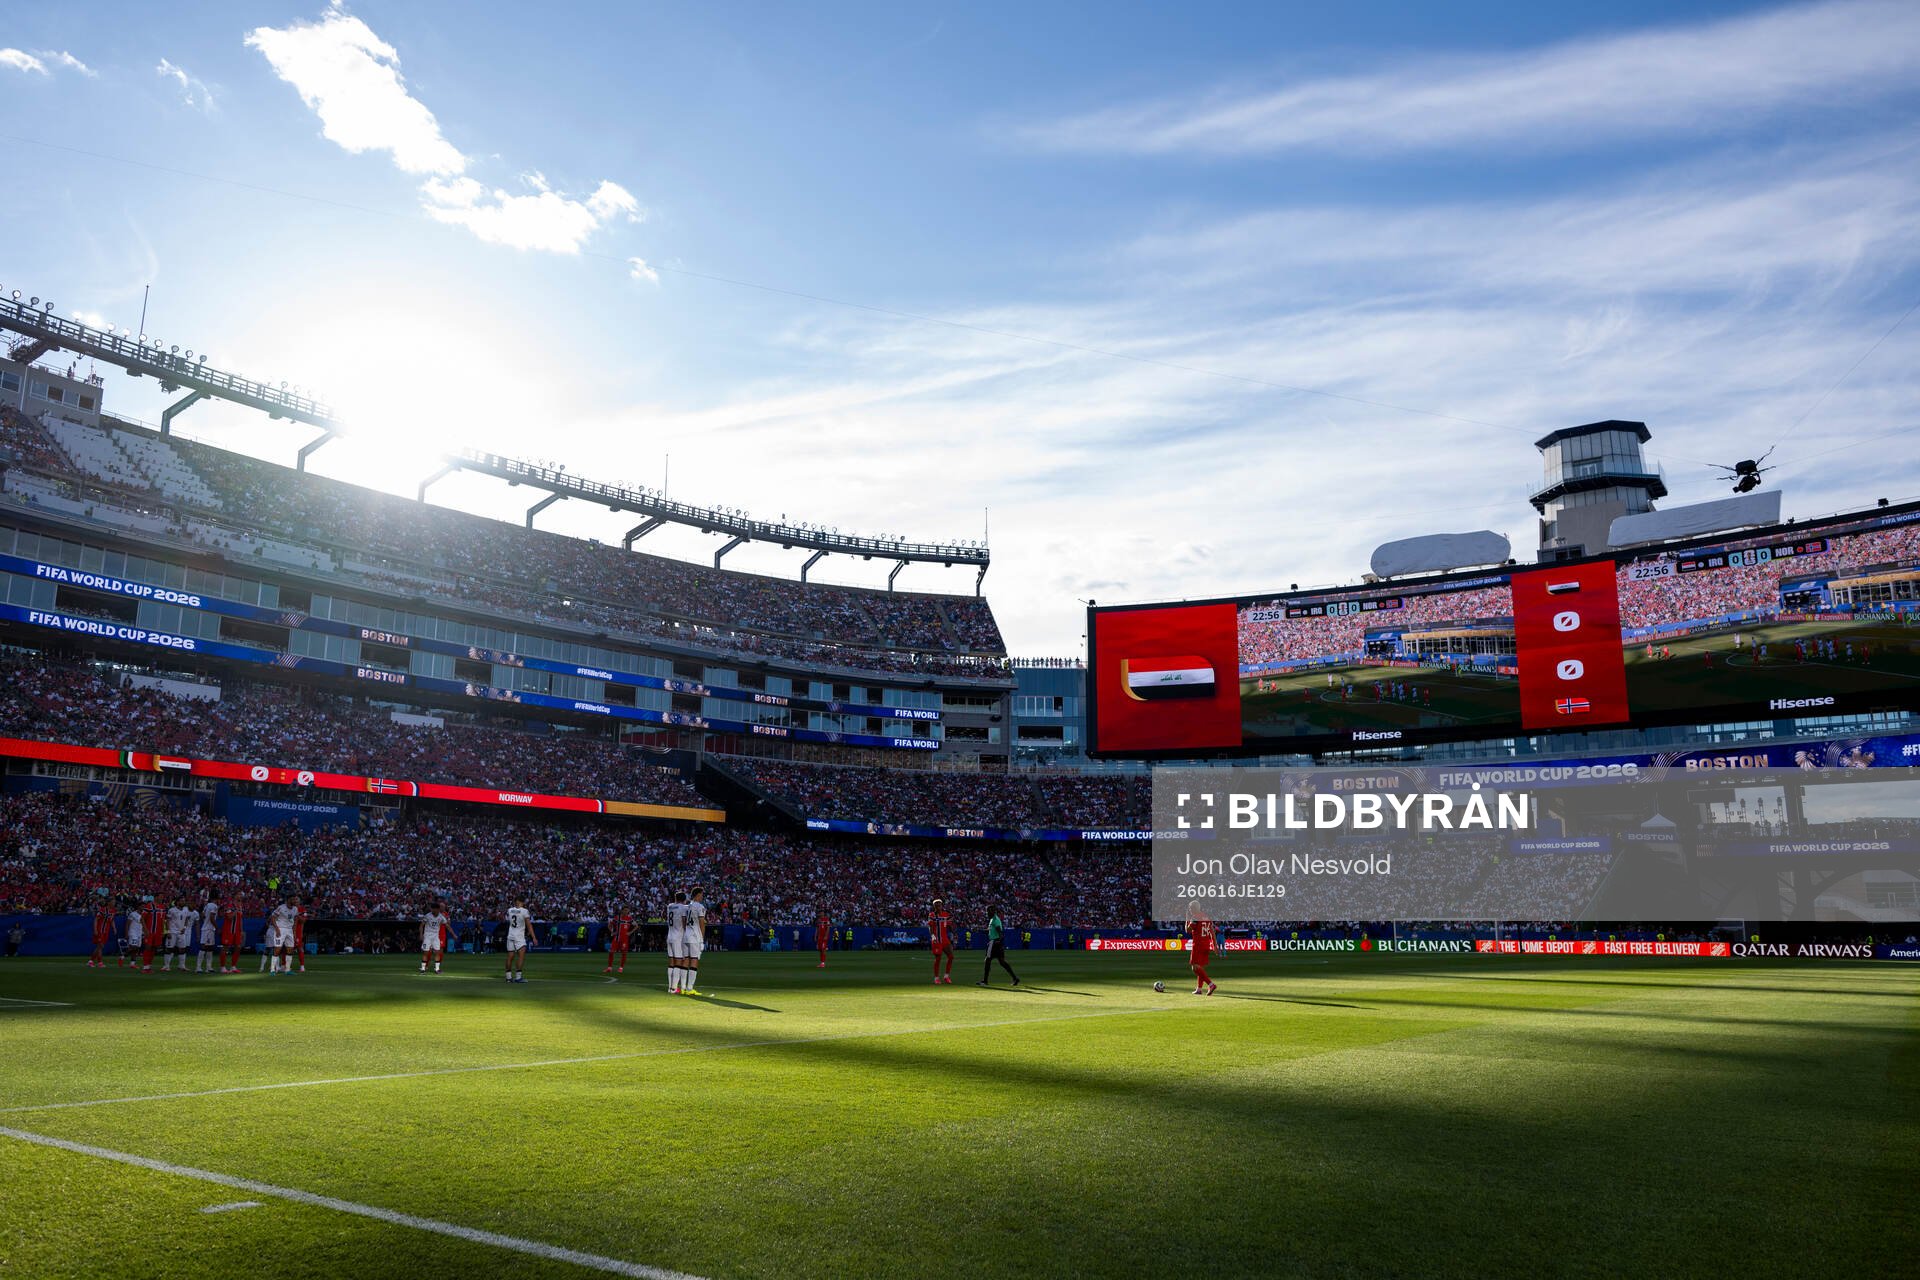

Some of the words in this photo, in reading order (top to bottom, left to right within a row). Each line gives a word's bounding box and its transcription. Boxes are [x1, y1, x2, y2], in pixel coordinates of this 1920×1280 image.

[1775, 546, 1794, 557] NOR
[1635, 565, 1669, 579] 22:56
[37, 564, 68, 582] FIFA
[71, 571, 122, 592] WORLD
[124, 583, 153, 597] CUP
[154, 590, 201, 606] 2026
[1252, 611, 1280, 621] 22:56
[30, 611, 61, 627] FIFA
[64, 617, 116, 637] WORLD
[118, 628, 146, 642] CUP
[148, 633, 195, 650] 2026
[362, 629, 409, 648] BOSTON
[357, 668, 405, 685] BOSTON
[577, 667, 613, 680] #FIFAWorldCup
[754, 694, 788, 706] BOSTON
[1770, 695, 1834, 711] Hisense
[574, 702, 611, 714] #FIFAWorldCup
[895, 709, 915, 719] FIFA
[753, 725, 787, 737] BOSTON
[1353, 730, 1402, 741] Hisense
[894, 738, 914, 748] FIFA
[1685, 754, 1769, 773] BOSTON
[1440, 773, 1473, 786] FIFA
[1476, 769, 1537, 784] WORLD
[1540, 767, 1574, 781] CUP
[1576, 763, 1638, 779] 2026
[1333, 776, 1399, 791] BOSTON
[498, 792, 533, 804] NORWAY
[253, 799, 270, 808] FIFA
[271, 801, 297, 811] WORLD
[298, 804, 312, 812] CUP
[313, 806, 338, 814] 2026
[947, 828, 984, 838] BOSTON
[1082, 831, 1101, 840] FIFA
[1103, 831, 1135, 840] WORLD
[1137, 831, 1154, 840] CUP
[1156, 831, 1188, 839] 2026
[1628, 833, 1674, 841] BOSTON
[1521, 842, 1535, 850] FIFA
[1536, 842, 1560, 850] WORLD
[1561, 841, 1575, 849] CUP
[1770, 844, 1791, 853] FIFA
[1792, 843, 1829, 852] WORLD
[1831, 843, 1851, 851] CUP
[1852, 842, 1890, 851] 2026
[511, 915, 517, 929] 3
[669, 911, 674, 927] 8
[1104, 940, 1163, 951] ExpressVPN
[1270, 939, 1355, 951] BUCHANAN'S
[1378, 939, 1471, 953] BUCHANAN'S
[1499, 941, 1515, 953] THE
[1546, 941, 1575, 954] DEPOT
[1604, 942, 1627, 954] FAST
[1630, 942, 1653, 955] FREE
[1656, 943, 1700, 956] DELIVERY
[1732, 942, 1790, 957] QATAR
[1797, 944, 1873, 958] AIRWAYS
[1890, 948, 1920, 957] Ameri
